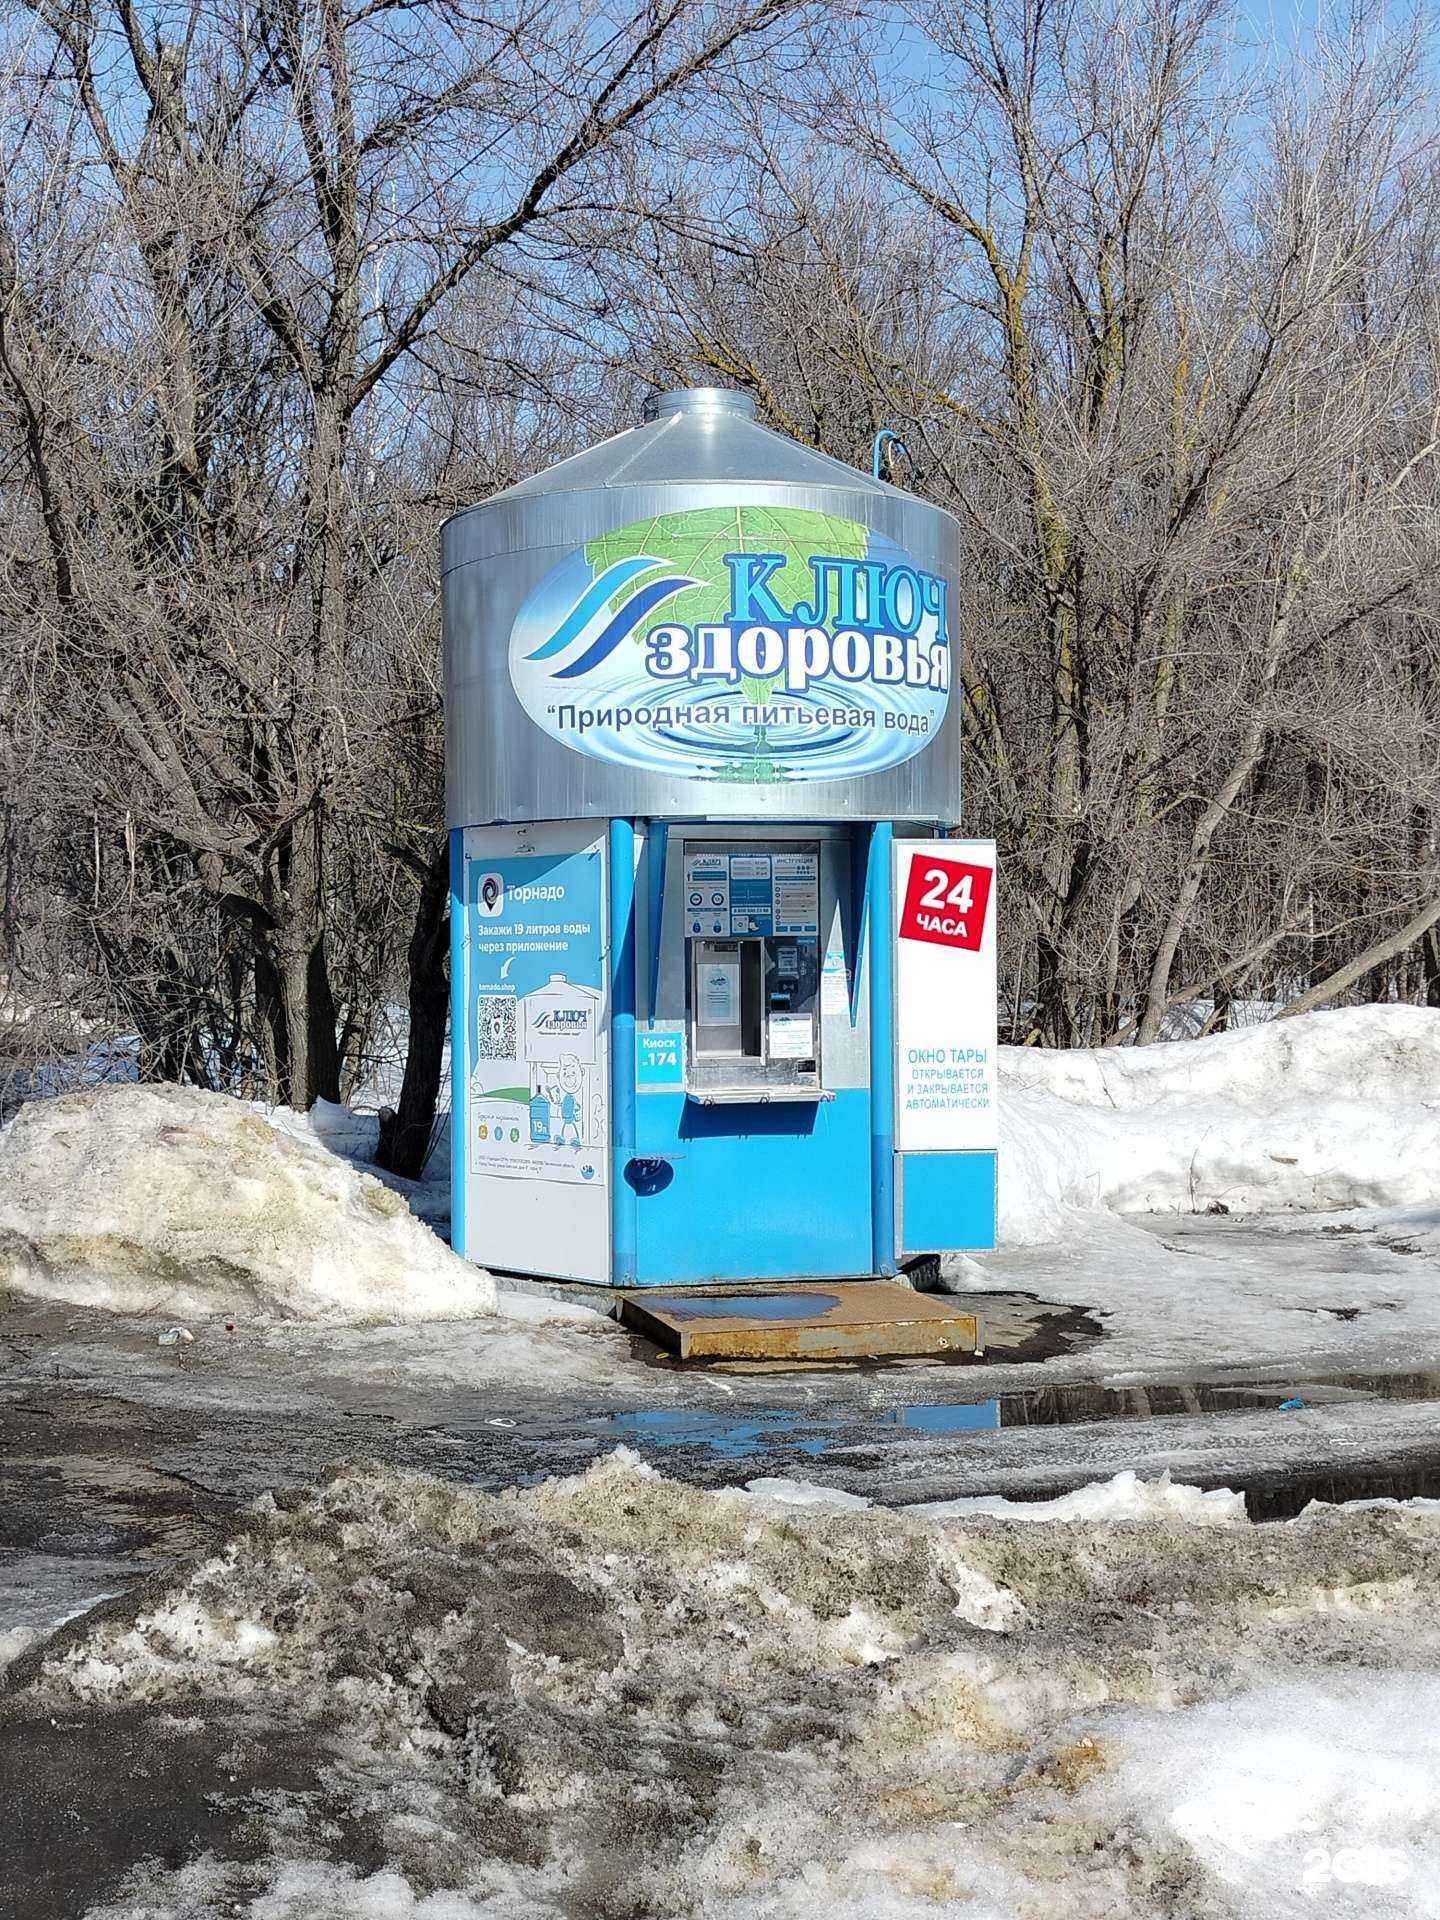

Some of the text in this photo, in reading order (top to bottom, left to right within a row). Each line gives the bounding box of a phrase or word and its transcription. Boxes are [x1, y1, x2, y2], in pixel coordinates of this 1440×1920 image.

[722, 553, 947, 642] КЛЮЧ
[644, 623, 951, 693] здоровья
[742, 706, 876, 731] питьевая
[507, 885, 565, 903] Торнадо
[919, 868, 974, 914] 24
[478, 923, 591, 937] Закажи 19 литров воды
[916, 912, 968, 938] ЧАСА
[478, 941, 568, 954] через приложение
[643, 1037, 676, 1049] Киоск
[908, 1048, 987, 1064] ОКНО ТАРЫ
[911, 1068, 984, 1080] ОТКРЫВАЕТСЯ
[907, 1083, 989, 1095] И ЗАКРЫВАЕТСЯ
[905, 1098, 991, 1110] АВТОМАТИЧЕСКИ
